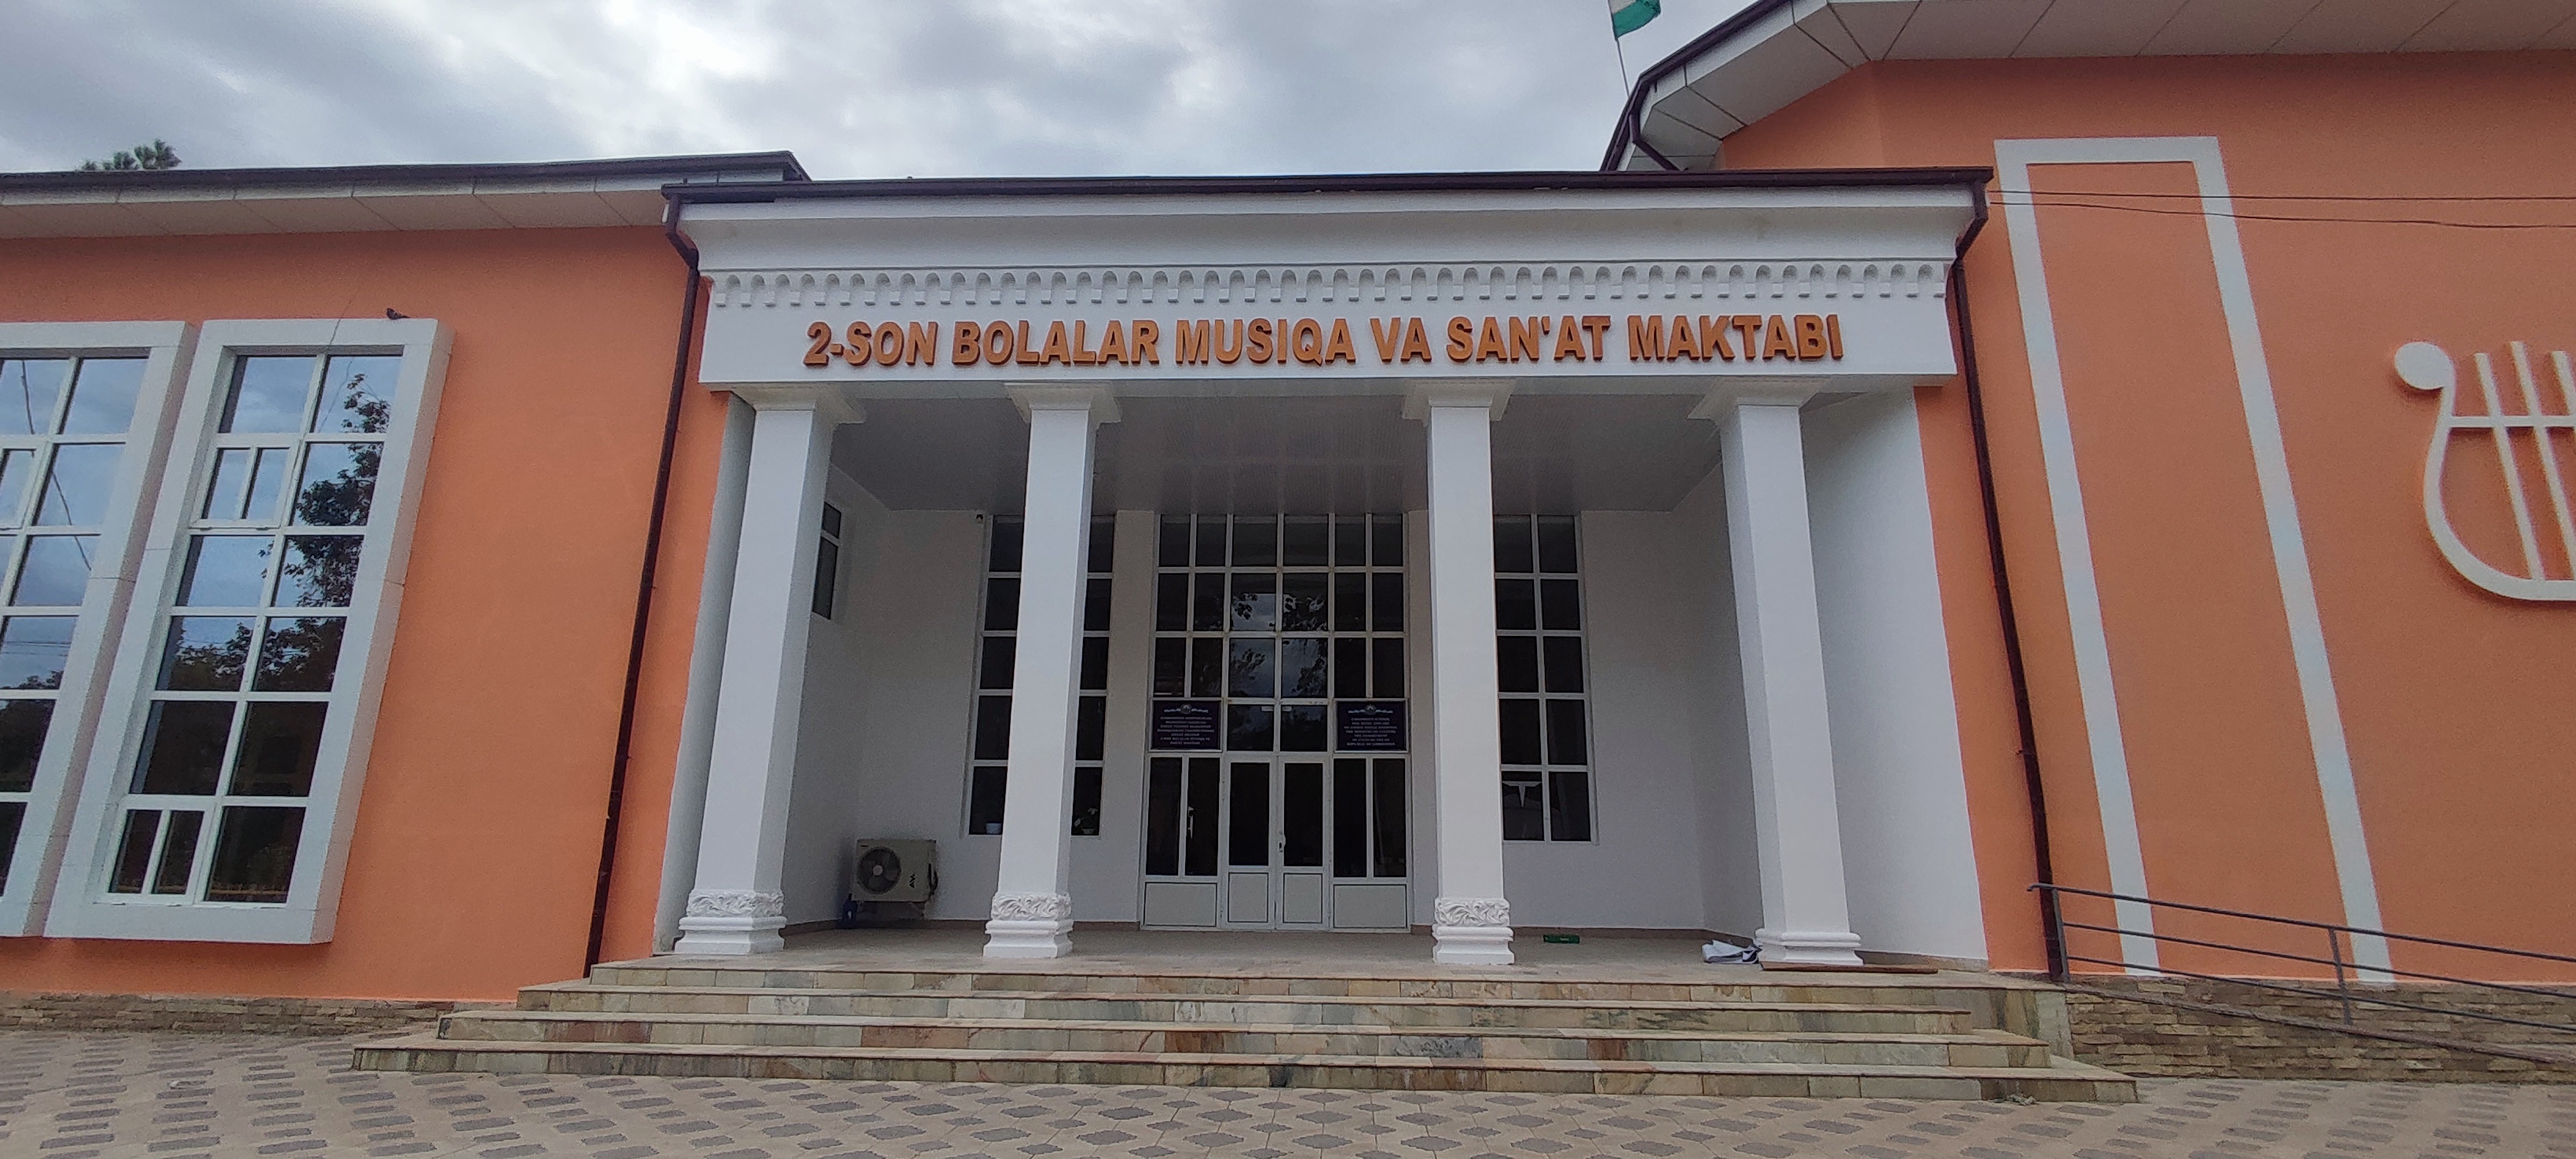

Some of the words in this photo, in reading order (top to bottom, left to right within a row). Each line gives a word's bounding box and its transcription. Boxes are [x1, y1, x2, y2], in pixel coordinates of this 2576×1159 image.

[803, 321, 938, 366] 2-SON
[952, 320, 1159, 366] BOLALAR
[1175, 318, 1356, 367] MUSIQA
[1370, 317, 1432, 364] VA
[1447, 316, 1610, 364] SAN'AT
[1627, 314, 1843, 362] MAKTABI
